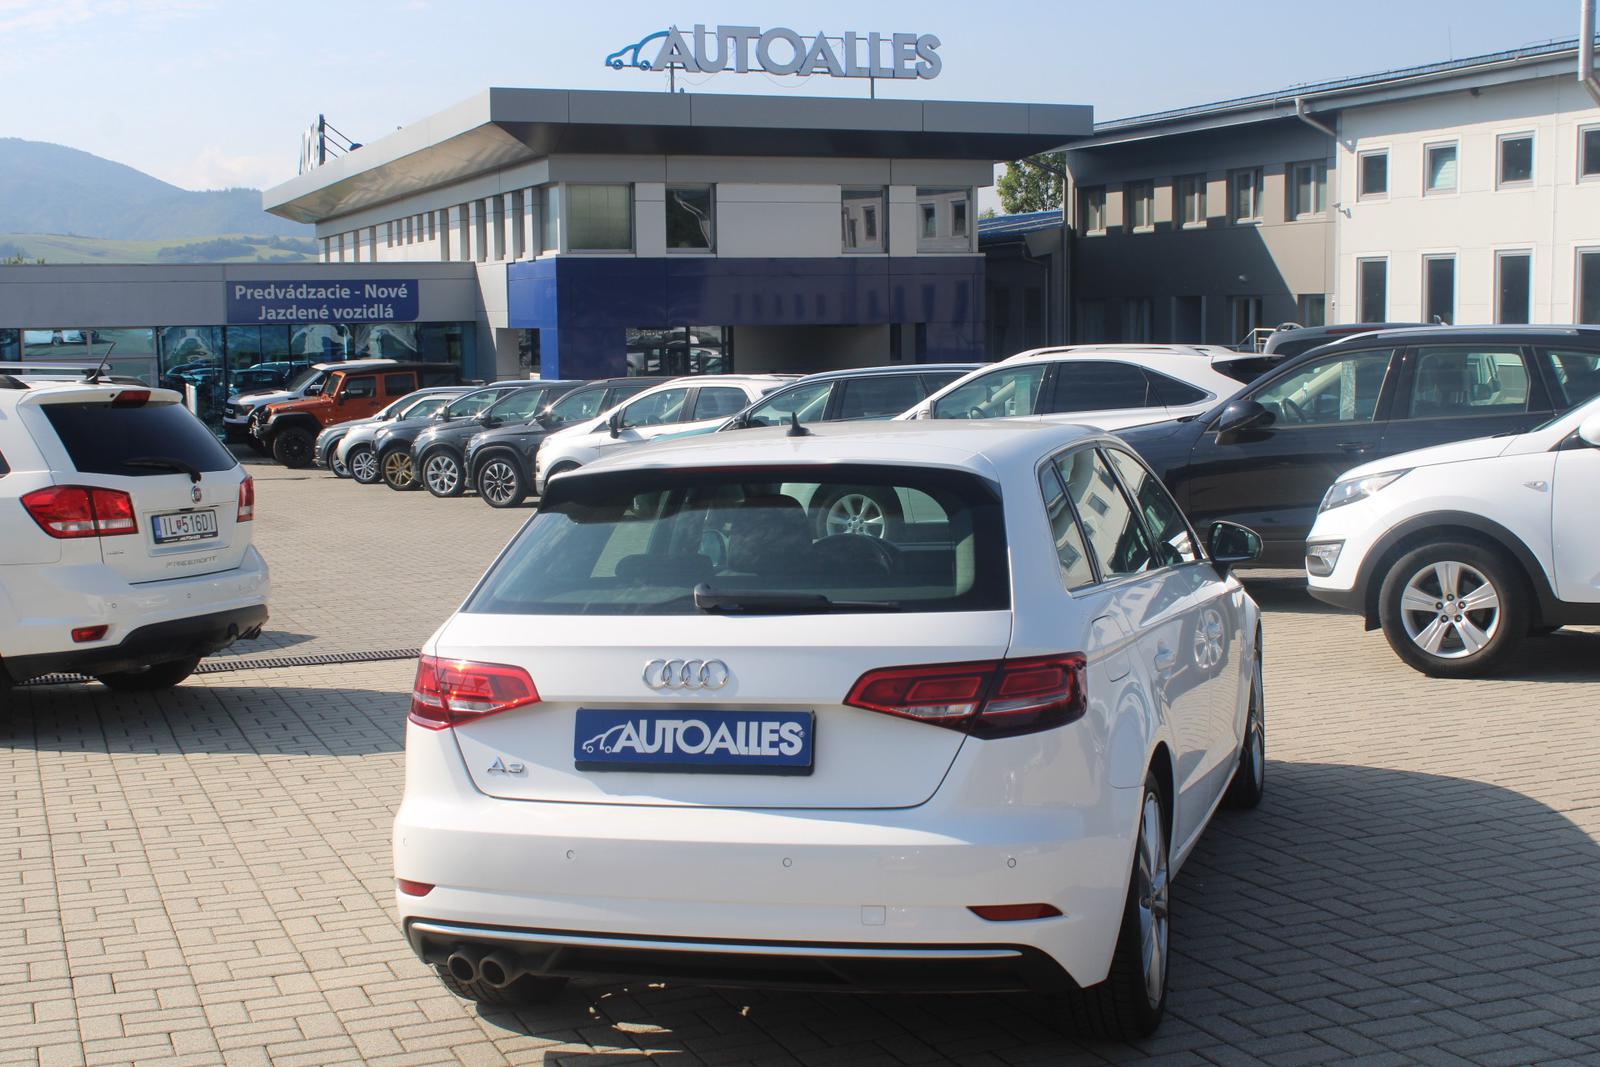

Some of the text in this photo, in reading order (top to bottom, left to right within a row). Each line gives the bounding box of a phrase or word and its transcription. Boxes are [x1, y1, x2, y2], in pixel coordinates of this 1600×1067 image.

[650, 24, 942, 80] AUTOALLES
[235, 285, 350, 299] Predvádzacie
[365, 283, 408, 298] Nové
[258, 304, 394, 320] Jazdené vozidlá
[611, 719, 803, 756] AUTOALLES
[487, 755, 525, 774] A3
